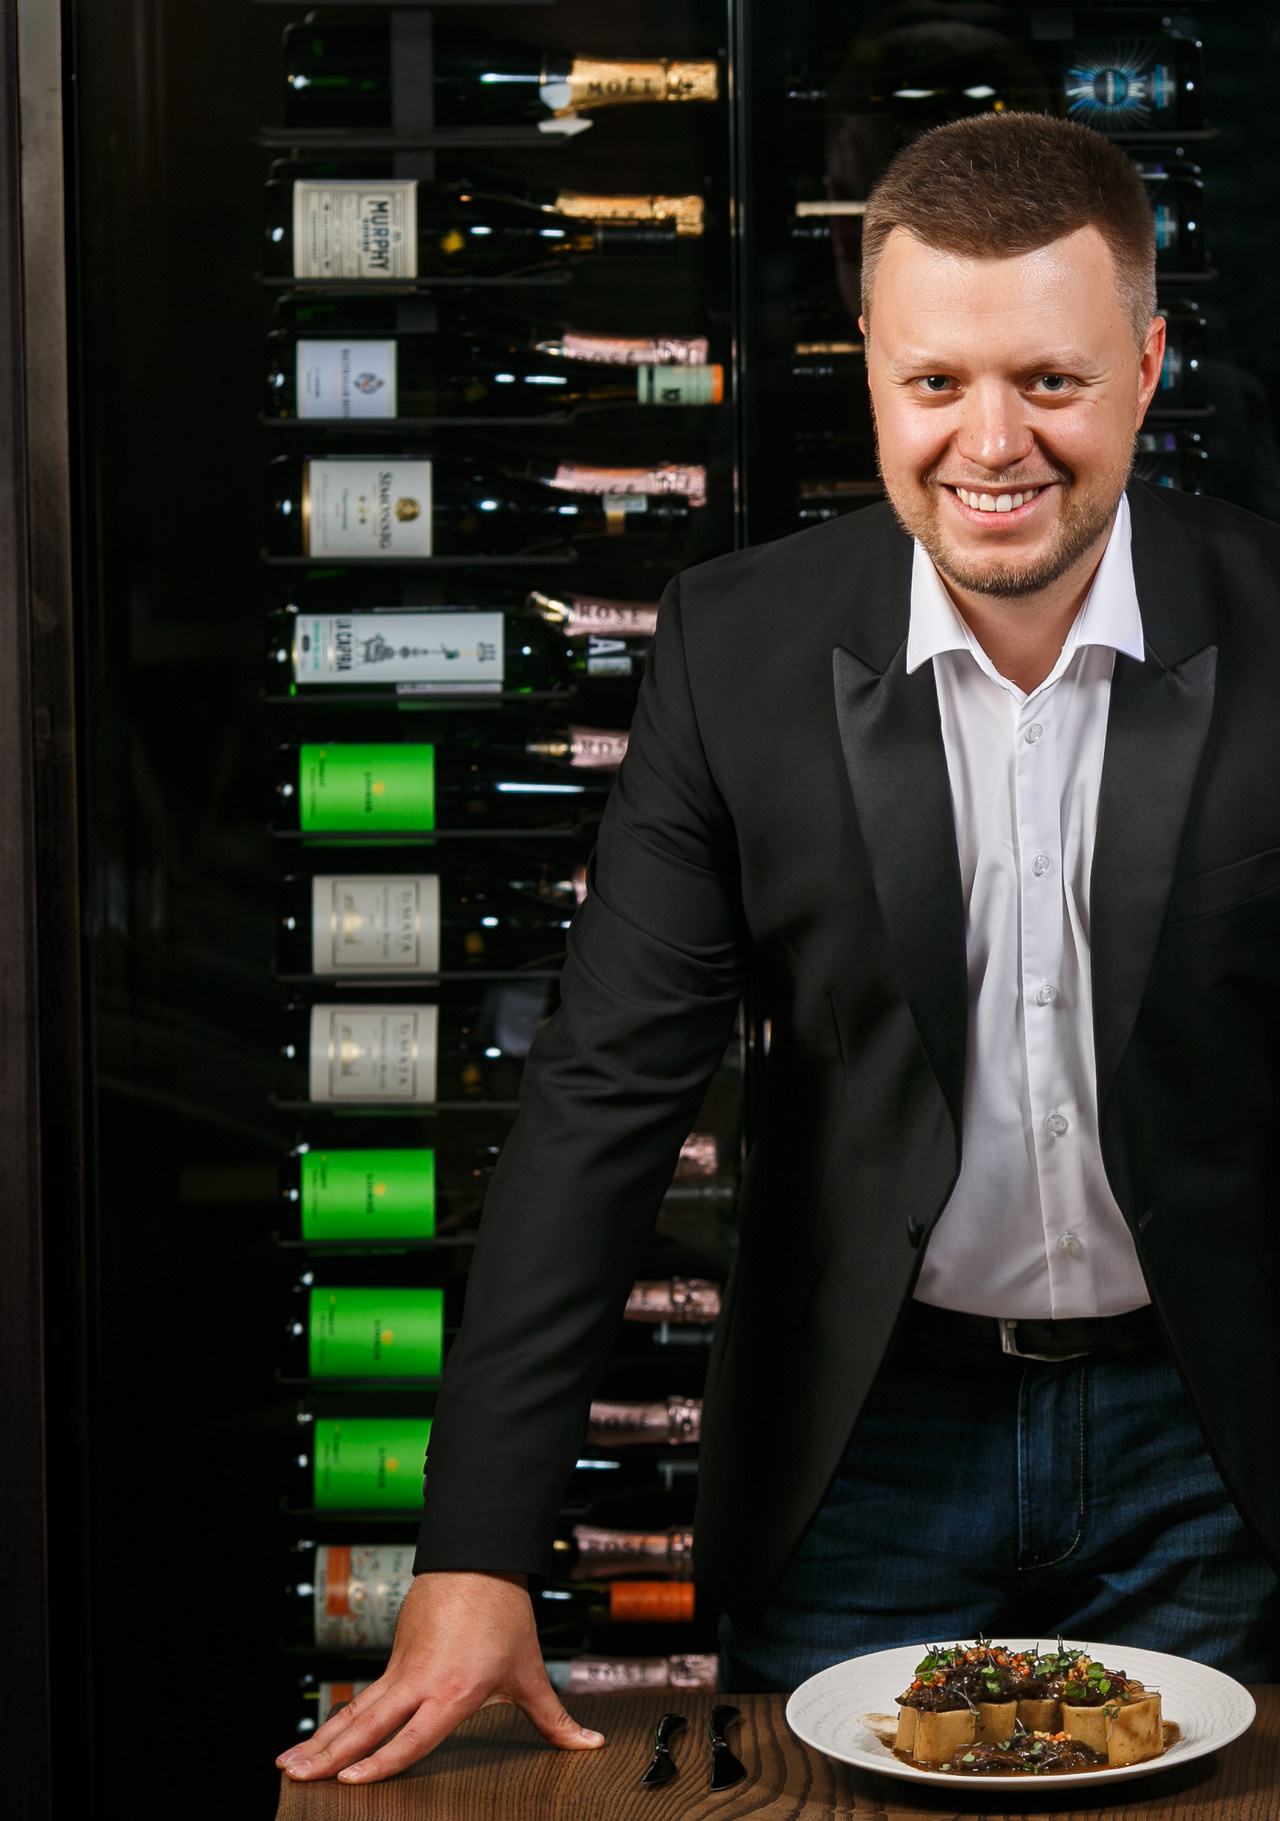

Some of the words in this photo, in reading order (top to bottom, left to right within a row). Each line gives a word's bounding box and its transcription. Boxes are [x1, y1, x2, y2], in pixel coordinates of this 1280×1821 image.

[588, 76, 652, 98] MOËT
[367, 200, 391, 271] MURPHY
[580, 738, 625, 757] ROS
